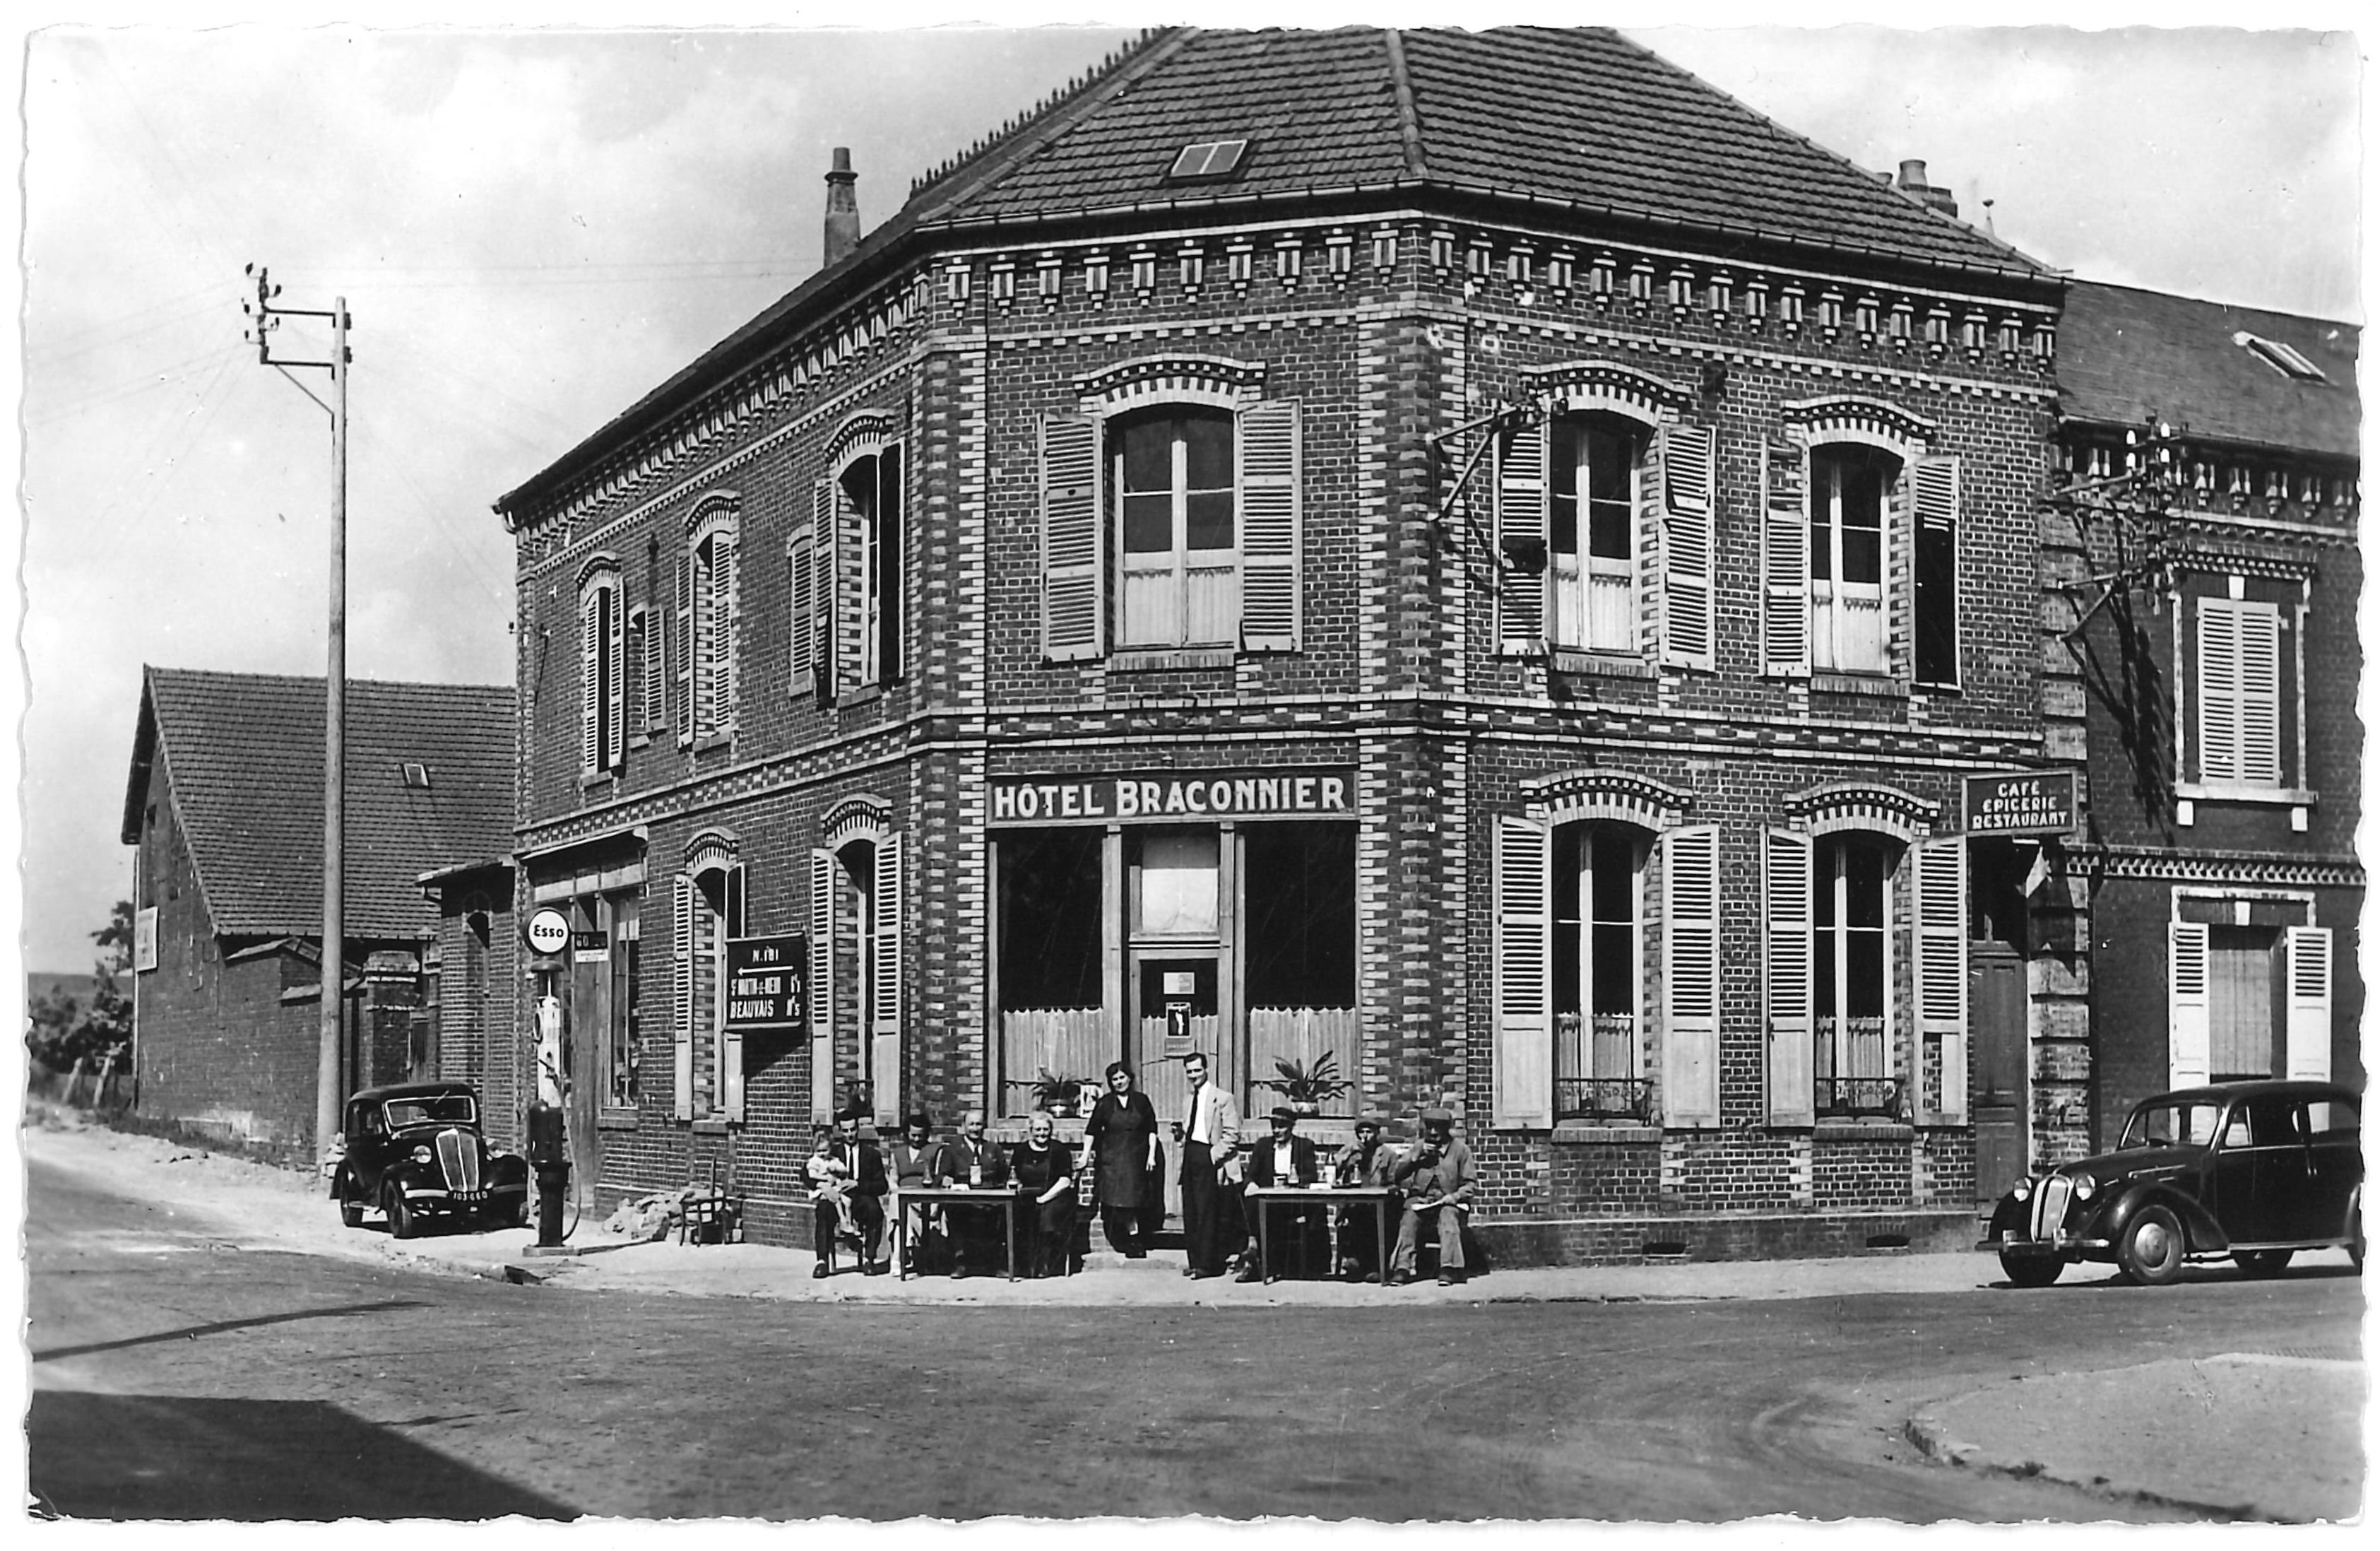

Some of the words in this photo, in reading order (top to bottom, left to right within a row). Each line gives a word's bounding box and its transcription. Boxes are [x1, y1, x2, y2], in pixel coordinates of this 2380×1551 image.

[1115, 777, 1346, 817] BRACONNIER
[1982, 796, 2057, 813] EPICERIE
[1972, 811, 2068, 830] RESTAURANT
[533, 924, 564, 938] Esso
[730, 999, 774, 1019] BEAUVAIS
